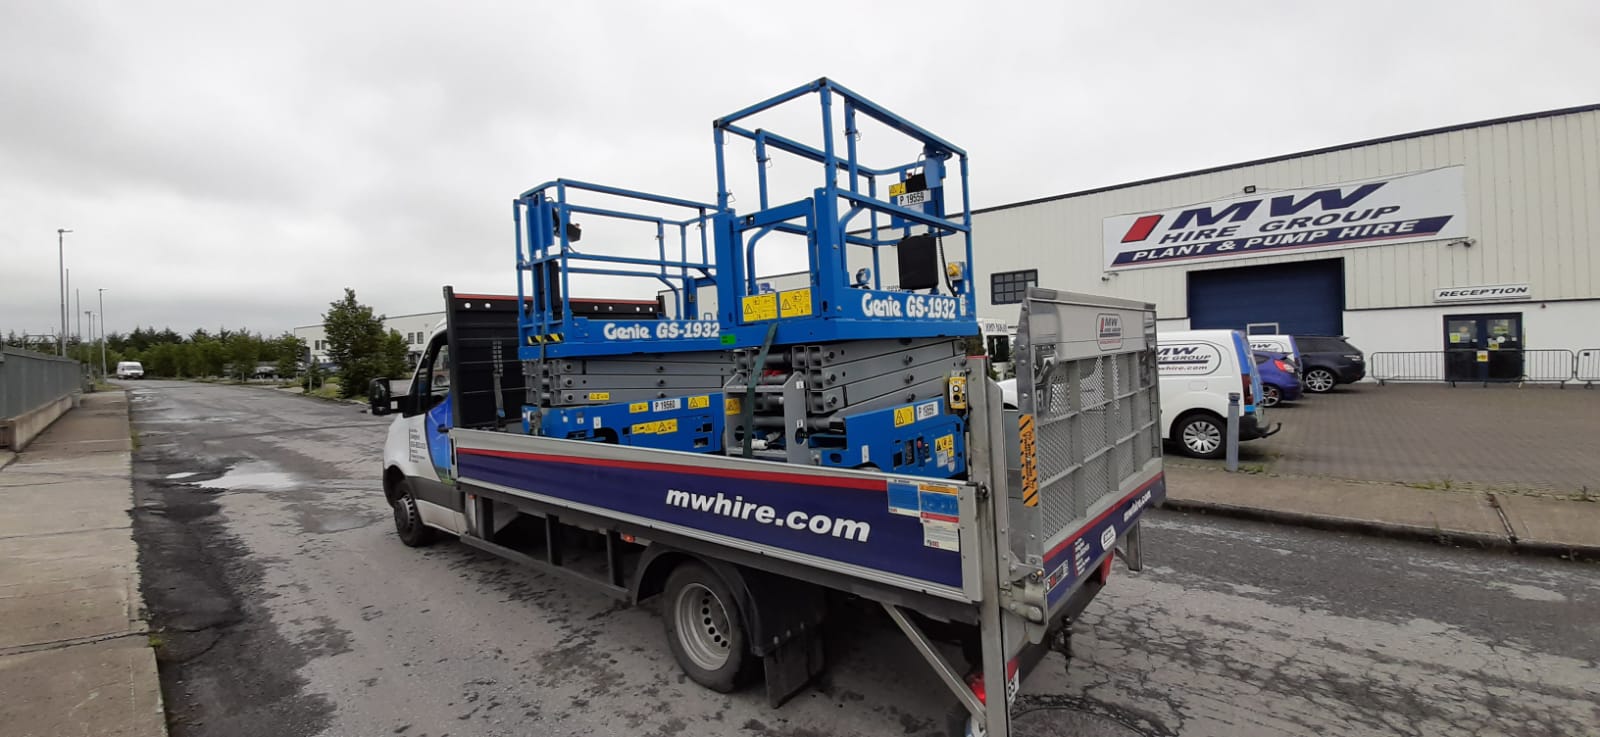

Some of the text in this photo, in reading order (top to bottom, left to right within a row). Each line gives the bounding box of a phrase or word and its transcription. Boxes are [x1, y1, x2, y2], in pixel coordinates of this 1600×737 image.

[1158, 205, 1401, 245] HIRE GROUP
[1168, 182, 1389, 231] MW
[1131, 220, 1420, 261] PLANT & PUMP HIRE
[861, 292, 903, 317] Genie
[906, 295, 956, 319] GS-1932
[1439, 286, 1529, 298] RECEPTION
[603, 322, 720, 340] Genie GS-1932
[665, 489, 871, 543] mwhire.com
